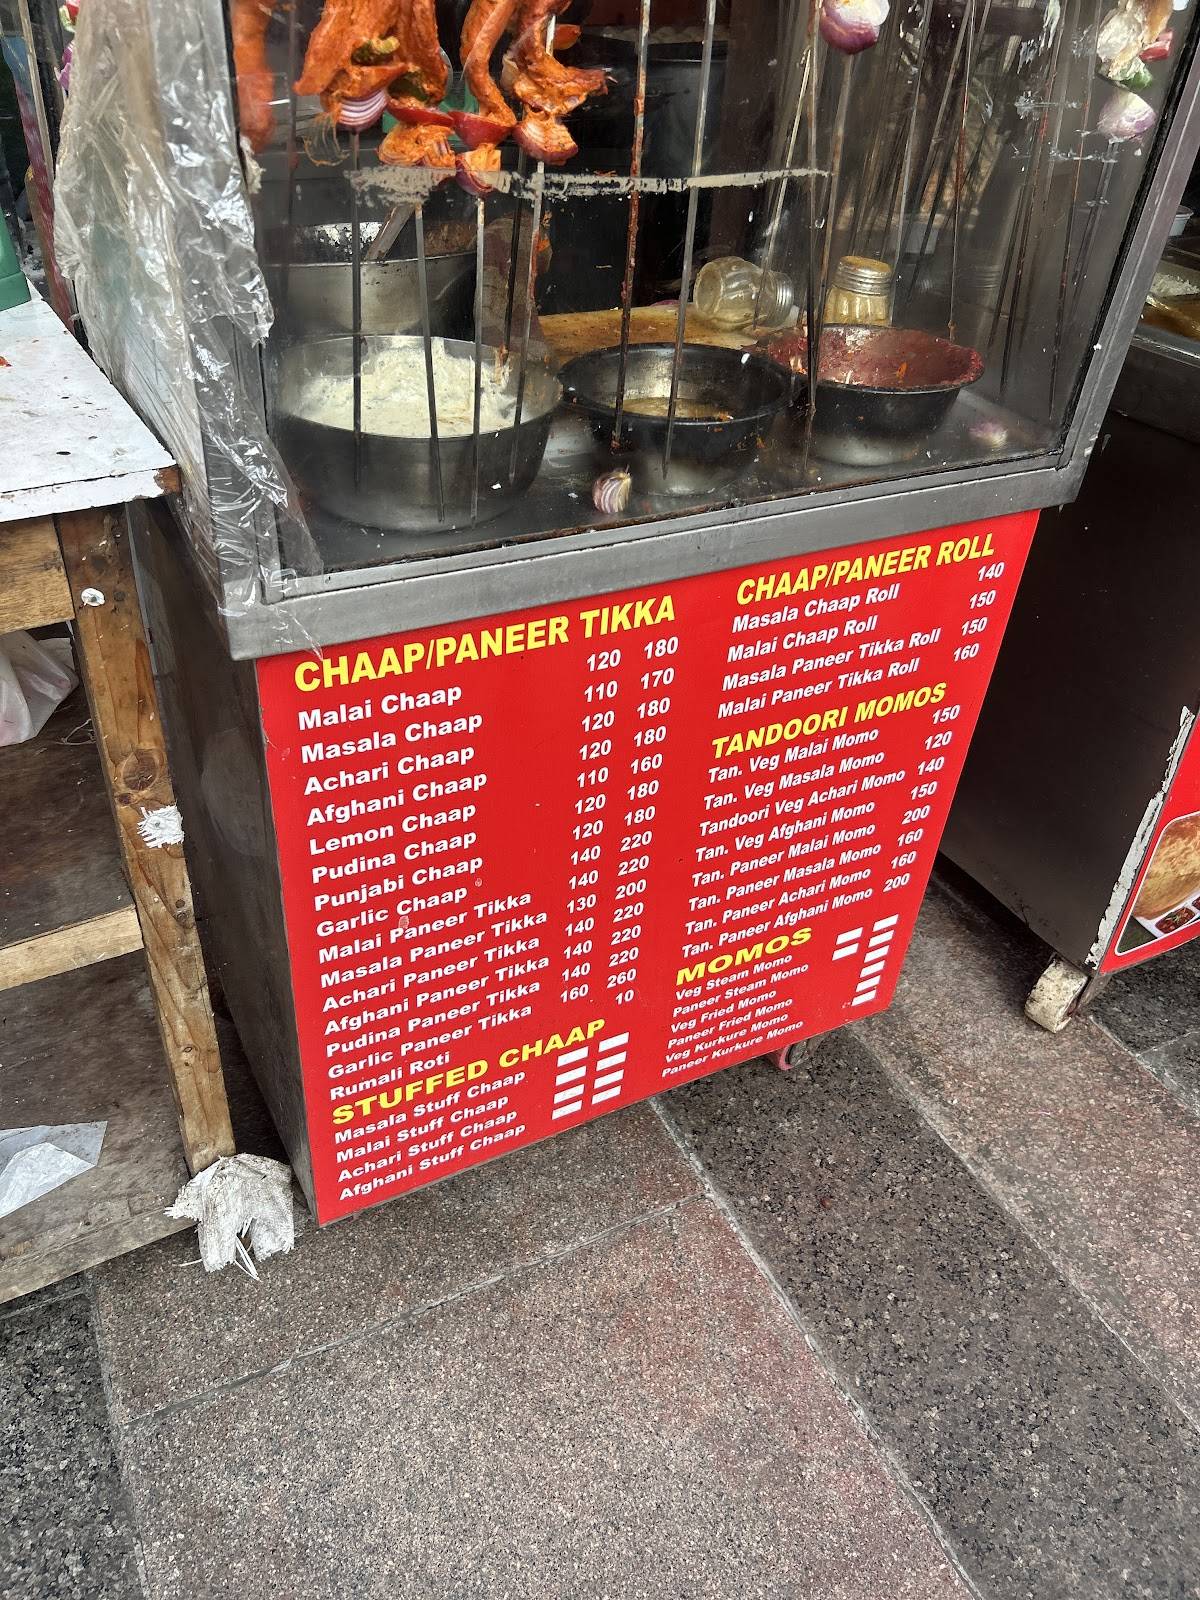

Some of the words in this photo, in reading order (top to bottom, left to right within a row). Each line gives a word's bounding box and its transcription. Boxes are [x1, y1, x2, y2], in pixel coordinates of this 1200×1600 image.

[731, 605, 799, 633] Masala
[803, 594, 861, 617] Chaap
[864, 582, 901, 605] Roll
[977, 561, 1005, 582] 140
[736, 544, 932, 605] CHAAP/PANEER
[935, 532, 995, 566] ROLL
[294, 615, 569, 692] CHAAP/PANEER
[579, 594, 675, 639] TIKKA
[722, 663, 787, 691] Masala
[791, 649, 854, 675] Paneer
[858, 638, 905, 659] Tikka
[907, 627, 942, 649] Roll
[961, 616, 988, 636] 150
[726, 636, 778, 663] Malai
[782, 626, 839, 650] Chaap
[842, 614, 878, 637] Roll
[969, 589, 997, 609] 150
[297, 698, 372, 731] Malai
[380, 686, 462, 714] Chaap
[586, 648, 621, 672] 120
[643, 635, 679, 659] 180
[301, 731, 396, 764] Masala
[404, 714, 483, 742] Chaap
[584, 679, 618, 703] 110
[640, 666, 675, 690] 170
[711, 705, 849, 759] TANDOORI
[853, 681, 947, 723] MOMOS
[717, 692, 767, 719] Malai
[770, 680, 833, 706] Paneer
[837, 668, 883, 689] Tikka
[886, 656, 920, 678] Roll
[953, 642, 980, 662] 160
[303, 761, 389, 796] Achari
[397, 746, 474, 775] Chaap
[581, 709, 615, 732] 120
[636, 696, 671, 719] 180
[306, 788, 404, 827] Afghani
[411, 773, 487, 801] Chaap
[578, 738, 612, 761] 120
[633, 725, 667, 747] 180
[703, 792, 738, 811] Tan.
[744, 781, 775, 799] Veg
[778, 763, 835, 790] Masala
[838, 751, 885, 774] Momo
[924, 730, 953, 751] 120
[707, 765, 743, 783] Tan.
[749, 753, 780, 773] Veg
[783, 737, 829, 764] Malai
[831, 728, 879, 751] Momo
[931, 704, 961, 725] 150
[309, 824, 394, 856] Lemon
[401, 804, 476, 833] Chaap
[576, 766, 609, 788] 110
[630, 752, 663, 774] 160
[311, 852, 396, 884] Pudina
[403, 831, 477, 860] Chaap
[574, 793, 606, 815] 120
[626, 779, 660, 801] 180
[695, 844, 729, 863] Tan.
[734, 833, 765, 851] Veg
[767, 811, 828, 842] Afghani
[830, 801, 875, 824] Momo
[910, 780, 938, 801] 150
[699, 803, 770, 837] Tandoori
[774, 797, 805, 816] Veg
[806, 779, 859, 807] Achari
[860, 769, 906, 791] Momo
[917, 755, 945, 776] 140
[314, 874, 404, 912] Punjabi
[411, 856, 483, 885] Chaap
[572, 819, 604, 841] 120
[623, 805, 656, 826] 180
[316, 906, 389, 937] Garlic
[395, 886, 468, 916] Chaap
[570, 844, 601, 866] 140
[619, 830, 653, 852] 220
[688, 894, 721, 912] Tan.
[725, 874, 781, 901] Paneer
[782, 856, 836, 883] Masala
[838, 843, 882, 866] Momo
[896, 827, 924, 847] 160
[691, 869, 725, 887] Tan.
[729, 850, 785, 877] Paneer
[787, 834, 829, 859] Malai
[831, 823, 876, 846] Momo
[901, 804, 931, 825] 200
[318, 932, 382, 964] Malai
[389, 911, 468, 944] Paneer
[473, 893, 531, 919] Tikka
[568, 869, 599, 890] 140
[617, 854, 650, 877] 220
[320, 955, 403, 989] Masala
[409, 930, 486, 963] Paneer
[490, 912, 547, 937] Tikka
[566, 893, 597, 914] 130
[614, 878, 647, 900] 200
[681, 940, 714, 958] Tan.
[718, 920, 772, 947] Paneer
[772, 899, 829, 929] Afghani
[831, 887, 873, 910] Momo
[882, 872, 911, 893] 200
[684, 917, 717, 935] Tan.
[721, 897, 776, 924] Paneer
[777, 879, 827, 906] Achari
[828, 868, 871, 890] Momo
[890, 850, 917, 869] 160
[322, 978, 396, 1013] Achari
[403, 956, 478, 989] Paneer
[483, 937, 540, 963] Tikka
[564, 916, 595, 937] 140
[612, 901, 644, 923] 220
[324, 997, 409, 1036] Afghani
[416, 975, 490, 1008] Paneer
[494, 956, 550, 982] Tikka
[563, 939, 593, 960] 140
[610, 924, 642, 946] 220
[672, 994, 722, 1018] Paneer
[724, 978, 767, 1000] Steam
[769, 963, 809, 984] Momo
[675, 926, 812, 986] MOMOS
[675, 985, 702, 1001] Veg
[705, 969, 750, 991] Steam
[752, 954, 793, 975] Momo
[326, 1026, 401, 1058] Pudina
[407, 1000, 481, 1033] Paneer
[485, 981, 540, 1007] Tikka
[561, 961, 591, 982] 140
[608, 946, 639, 968] 220
[327, 1051, 394, 1079] Garlic
[400, 1024, 473, 1057] Paneer
[477, 1005, 532, 1031] Tikka
[560, 983, 589, 1003] 160
[606, 967, 637, 989] 260
[665, 1048, 691, 1063] Veg
[693, 1028, 747, 1053] Kurkure
[749, 1013, 789, 1033] Momo
[667, 1025, 716, 1049] Paneer
[718, 1010, 752, 1031] Fried
[754, 998, 793, 1018] Momo
[670, 1018, 697, 1033] Veg
[700, 1002, 735, 1023] Fried
[737, 990, 777, 1010] Momo
[329, 1066, 403, 1101] Rumali
[409, 1050, 450, 1075] Roti
[615, 988, 635, 1005] 10
[332, 1059, 489, 1125] STUFFED
[498, 1018, 605, 1068] CHAAP
[661, 1054, 709, 1078] Paneer
[710, 1035, 764, 1060] Kurkure
[765, 1020, 804, 1040] Momo
[334, 1112, 407, 1145] Masala
[413, 1090, 461, 1117] Stuff
[466, 1071, 525, 1099] Chaap
[336, 1134, 391, 1164] Malai
[396, 1115, 444, 1142] Stuff
[449, 1095, 509, 1123] Chaap
[337, 1149, 402, 1183] Achari
[407, 1130, 454, 1157] Stuff
[459, 1110, 517, 1138] Chaap
[339, 1163, 413, 1201] Afghani
[418, 1144, 465, 1171] Stuff
[469, 1124, 526, 1151] Chaap
